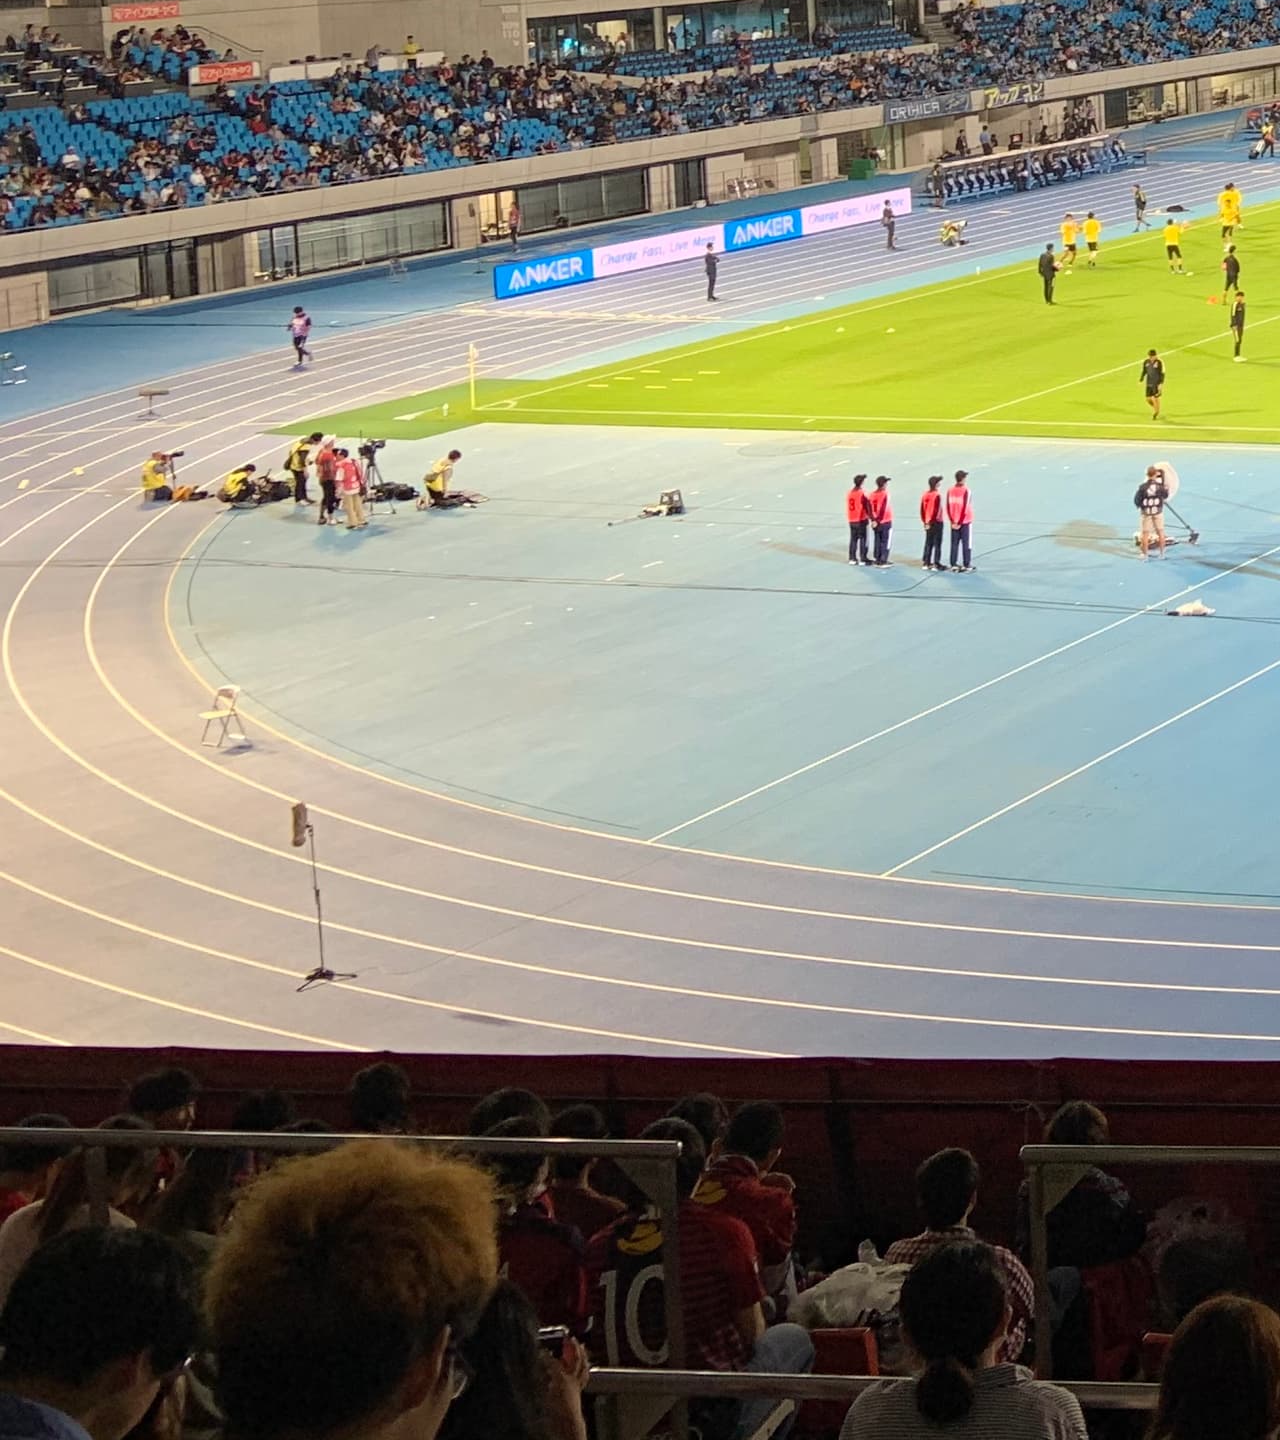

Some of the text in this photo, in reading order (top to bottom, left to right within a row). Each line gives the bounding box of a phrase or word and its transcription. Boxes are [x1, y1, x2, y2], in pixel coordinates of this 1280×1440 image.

[889, 101, 940, 120] ORIHICA
[733, 214, 794, 247] ANKER
[509, 257, 584, 292] ANKER
[599, 1263, 669, 1366] 10
